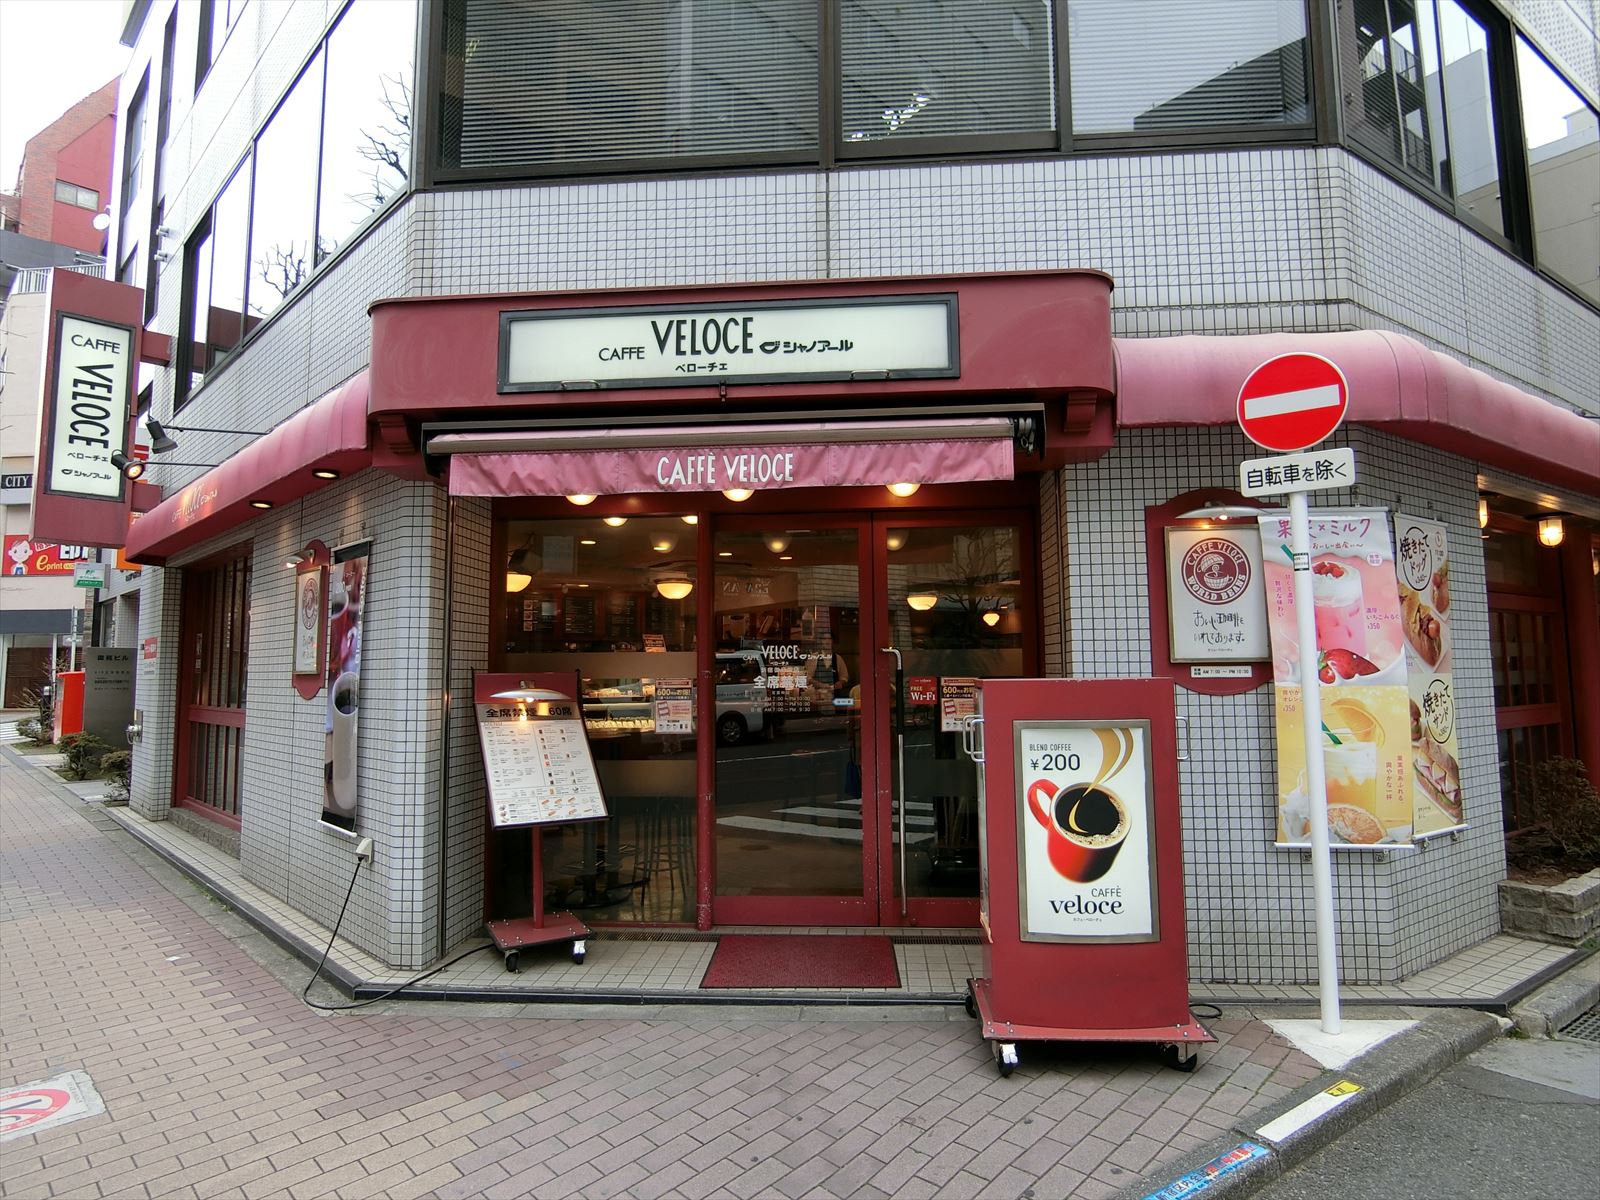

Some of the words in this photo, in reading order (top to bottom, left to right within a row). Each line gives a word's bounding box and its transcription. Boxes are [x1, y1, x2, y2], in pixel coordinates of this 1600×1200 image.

[71, 334, 121, 354] CAFFE
[598, 346, 645, 362] CAFFE
[651, 317, 754, 357] VELOCE
[782, 338, 853, 353] シャノアール
[675, 362, 728, 373] ベローチェ
[68, 364, 114, 449] VELOCE
[67, 452, 109, 462] ベローチェ
[723, 453, 794, 483] VELOCE
[1247, 459, 1347, 488] 自転車を除く
[5, 475, 29, 488] CITY
[1217, 542, 1244, 564] VELOCE
[1400, 534, 1430, 562] 焼きたて
[1187, 575, 1217, 601] WORLD
[1221, 575, 1246, 600] BEANS
[762, 645, 798, 660] VELOCE
[1423, 685, 1450, 718] 焼きたて
[1029, 743, 1048, 752] BLEND
[1050, 743, 1072, 752] COFFEE
[1030, 753, 1081, 771] ¥200
[1049, 894, 1125, 915] veloce
